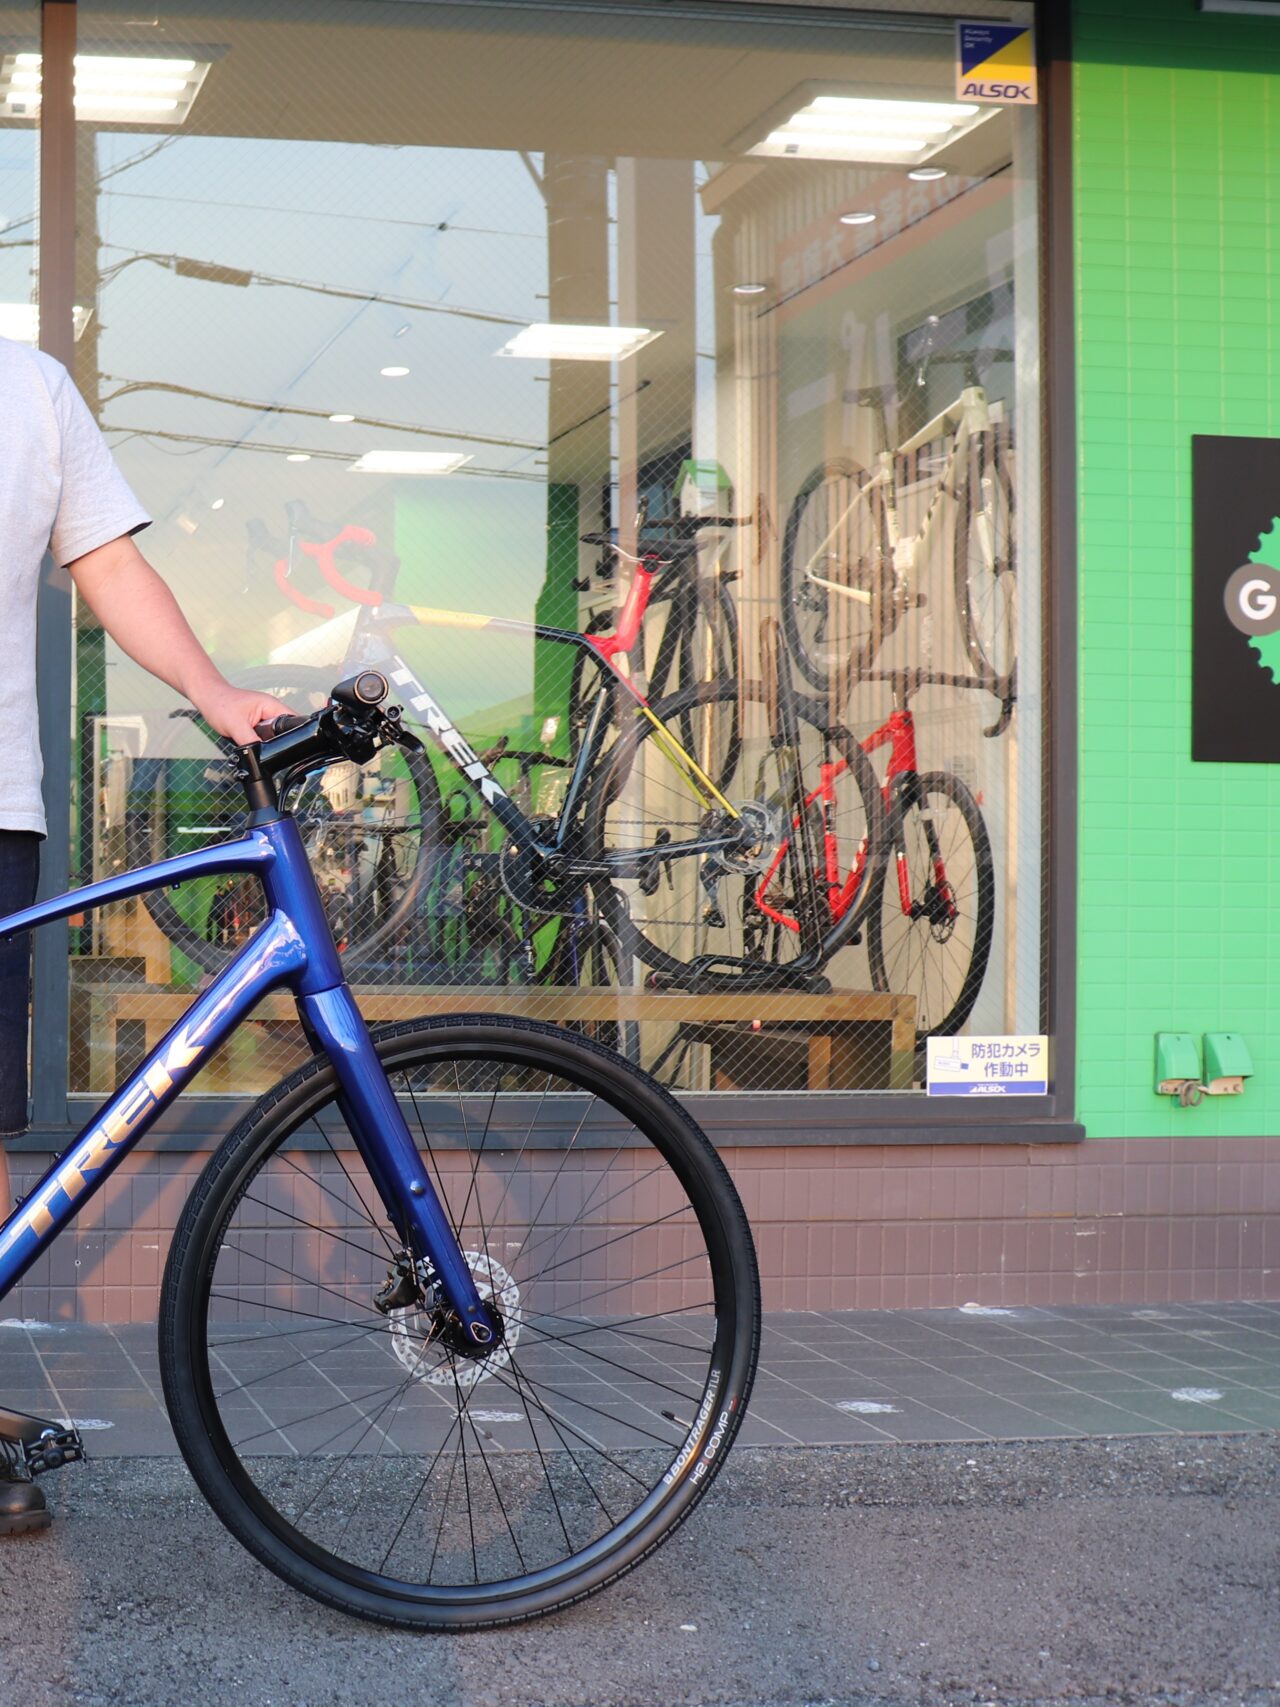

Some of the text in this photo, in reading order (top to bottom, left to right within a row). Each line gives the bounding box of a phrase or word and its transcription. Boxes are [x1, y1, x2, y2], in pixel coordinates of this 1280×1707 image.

[962, 83, 1032, 100] ALSOK
[1239, 579, 1277, 620] G
[389, 655, 508, 805] TREK
[971, 1043, 1041, 1059] 防犯カメラ
[984, 1062, 1029, 1077] 作動中
[9, 1024, 206, 1239] TREK
[671, 1369, 721, 1478] BONTRAGER TLR
[689, 1411, 729, 1485] H2 COMP
